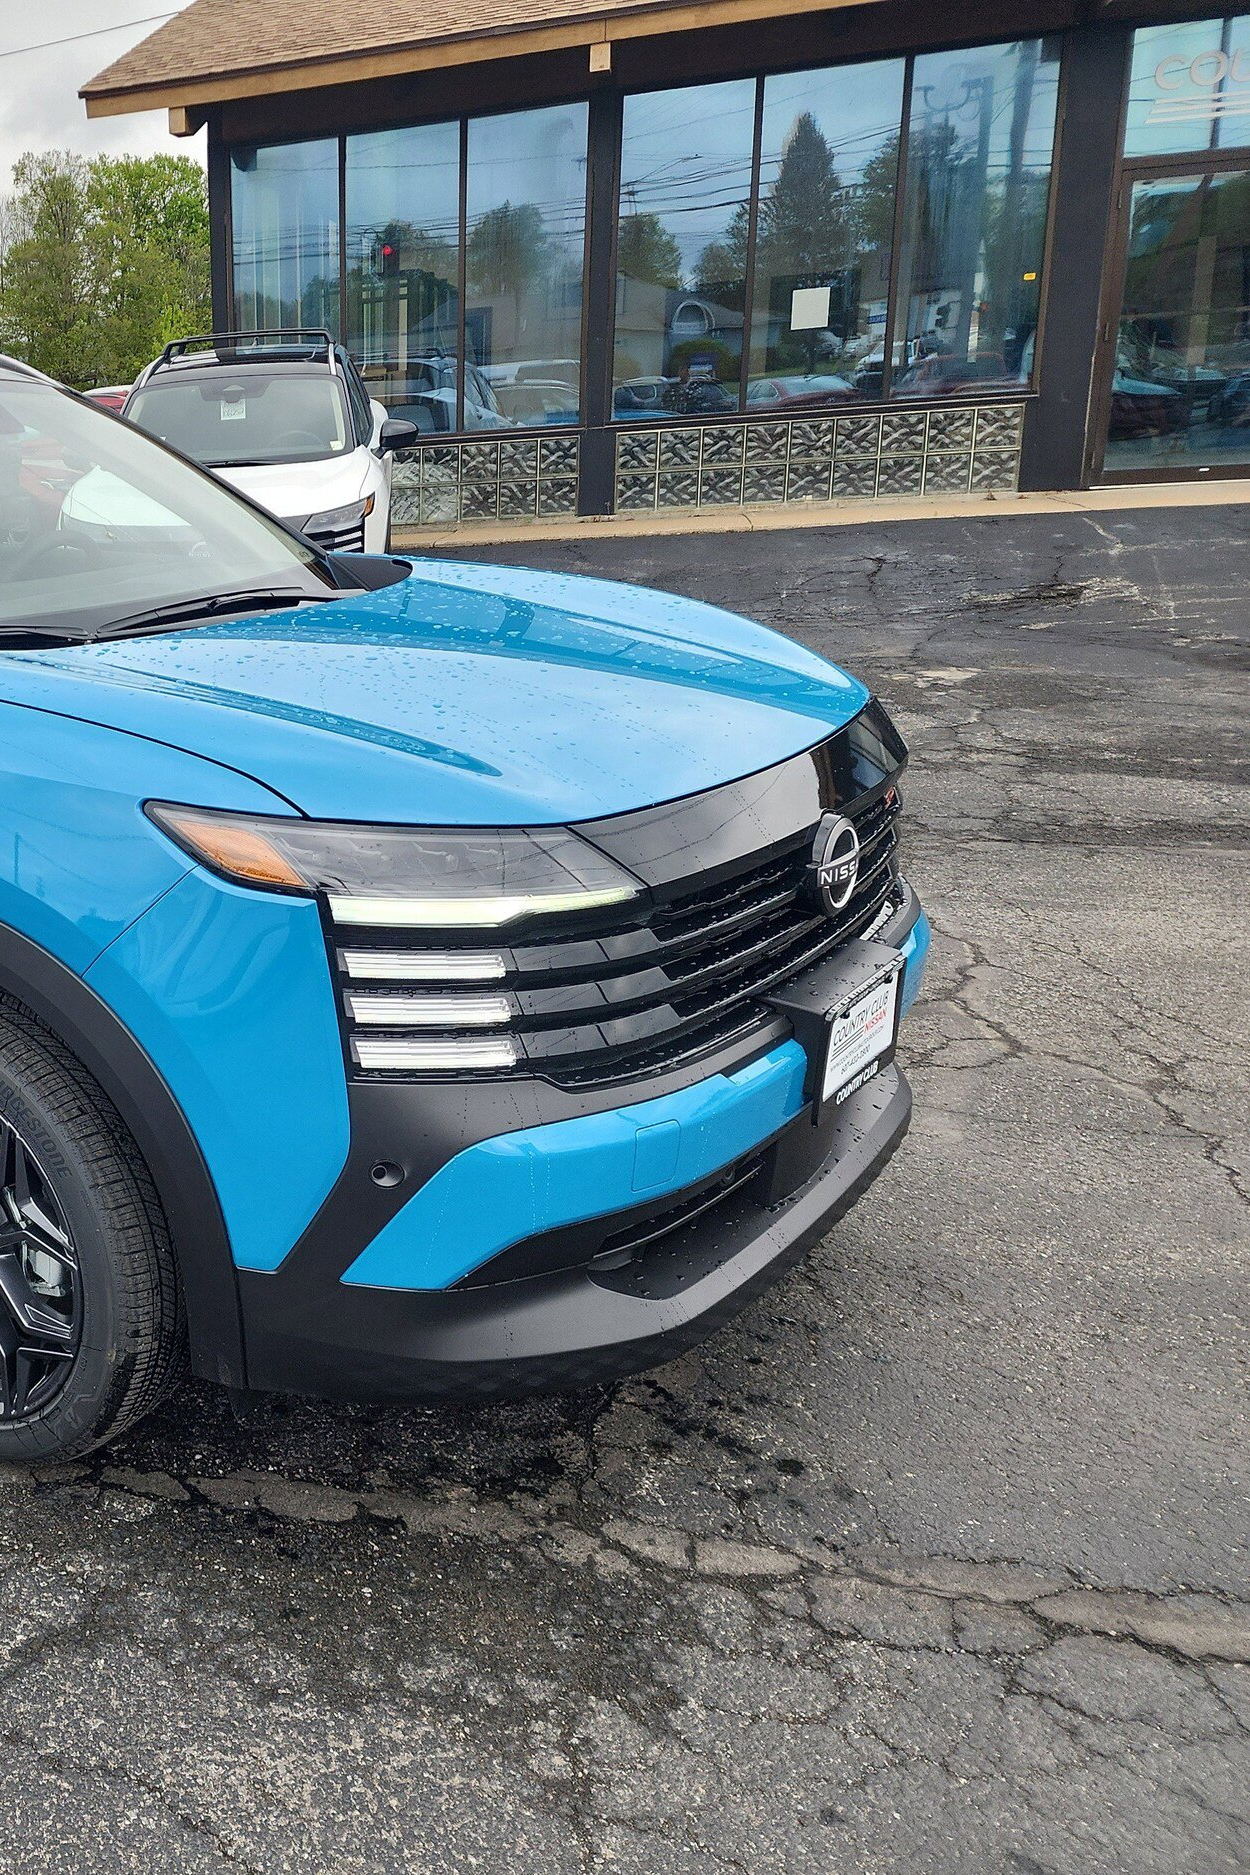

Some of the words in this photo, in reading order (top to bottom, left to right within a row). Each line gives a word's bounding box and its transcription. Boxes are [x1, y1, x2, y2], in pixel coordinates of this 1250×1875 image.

[820, 860, 856, 885] NISS
[833, 1004, 871, 1046] COUNTRY
[870, 990, 889, 1016] CLUB
[864, 1008, 888, 1033] NISSAN
[836, 1074, 863, 1105] COUNTRY
[862, 1060, 879, 1081] CLUB
